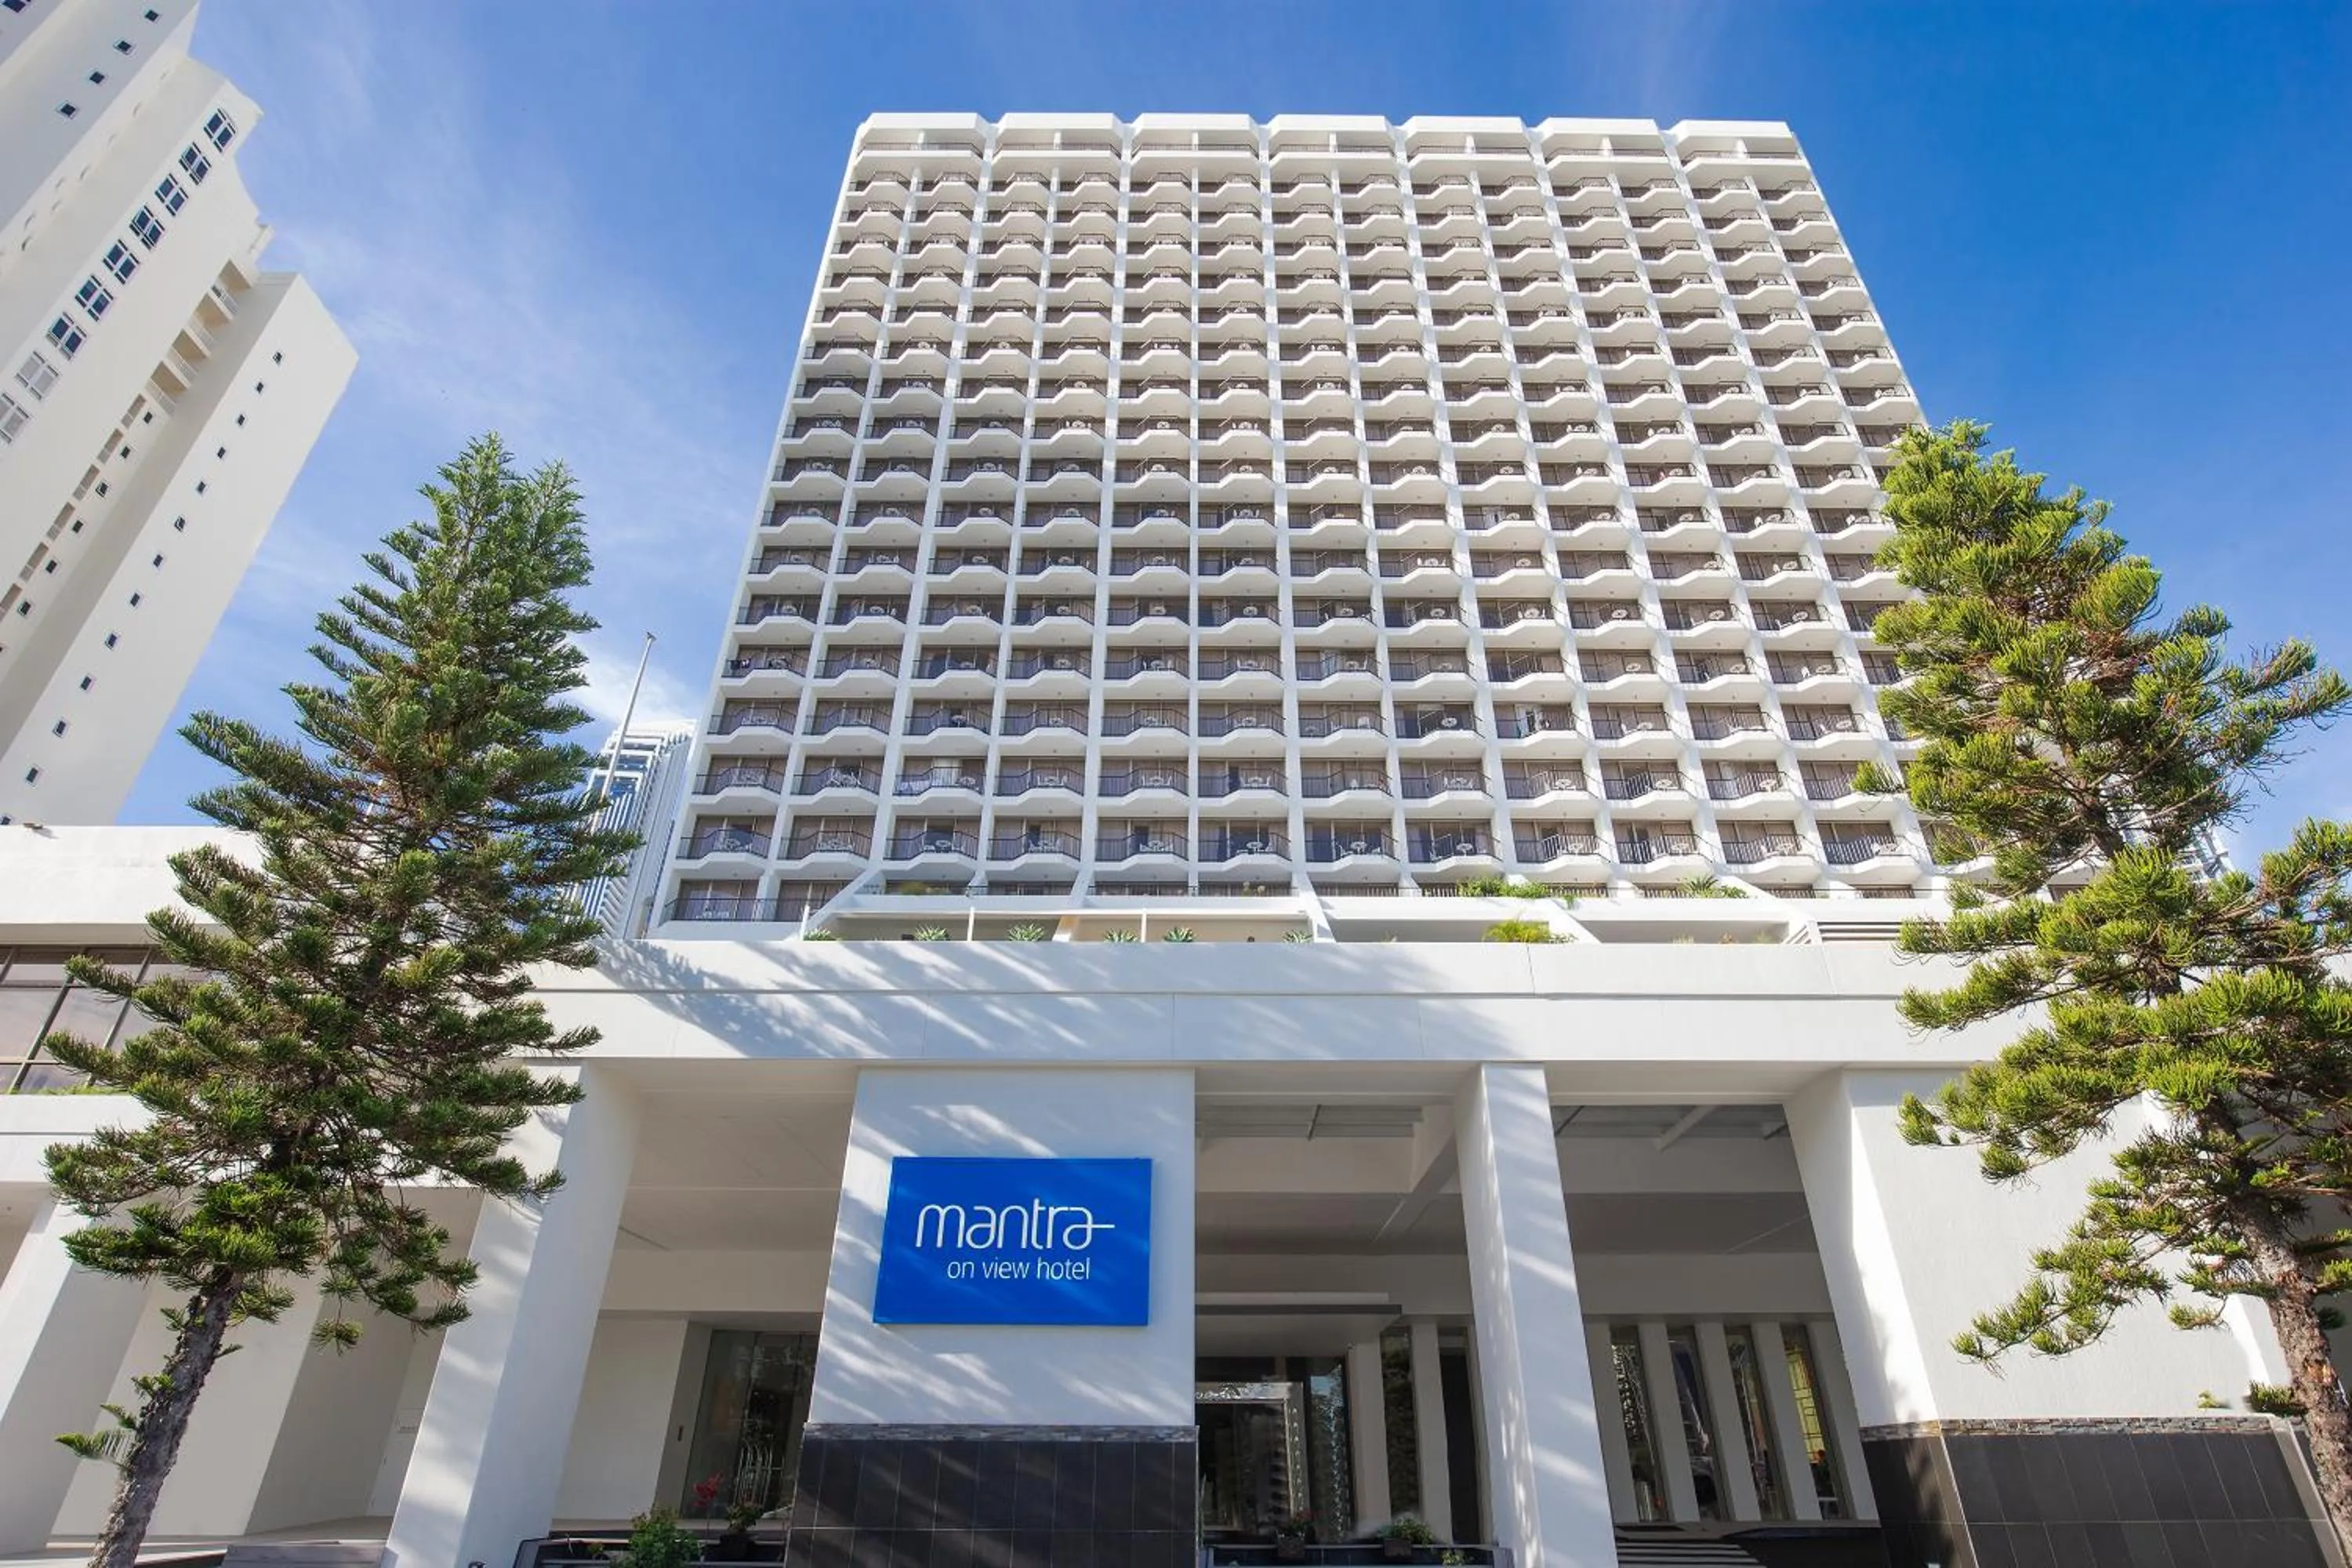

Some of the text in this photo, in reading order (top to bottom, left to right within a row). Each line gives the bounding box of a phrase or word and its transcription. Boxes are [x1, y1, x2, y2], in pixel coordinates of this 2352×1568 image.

[915, 1198, 1116, 1250] mantra
[947, 1258, 1091, 1279] on view hotel
